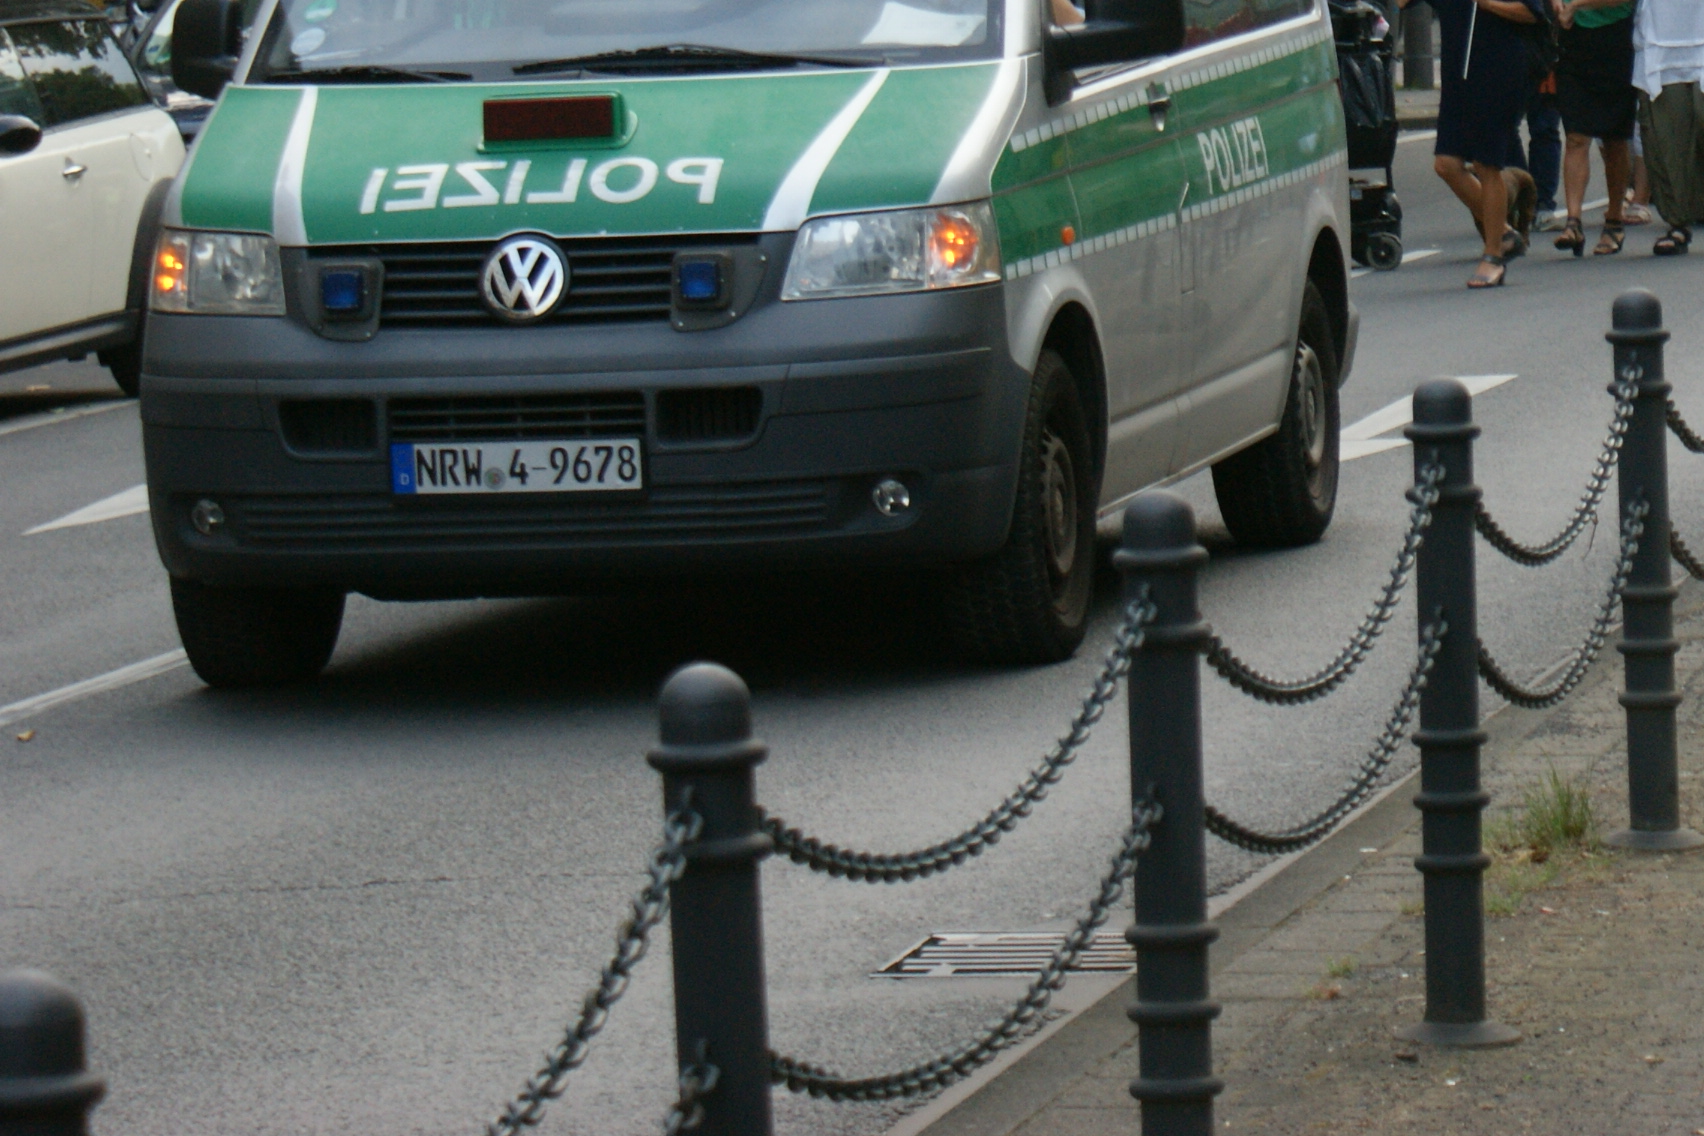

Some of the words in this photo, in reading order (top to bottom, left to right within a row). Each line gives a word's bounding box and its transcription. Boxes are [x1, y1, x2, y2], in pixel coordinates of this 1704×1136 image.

[1197, 116, 1270, 196] POLIZEI
[415, 448, 483, 488] NRW
[508, 444, 638, 485] 4-9678
